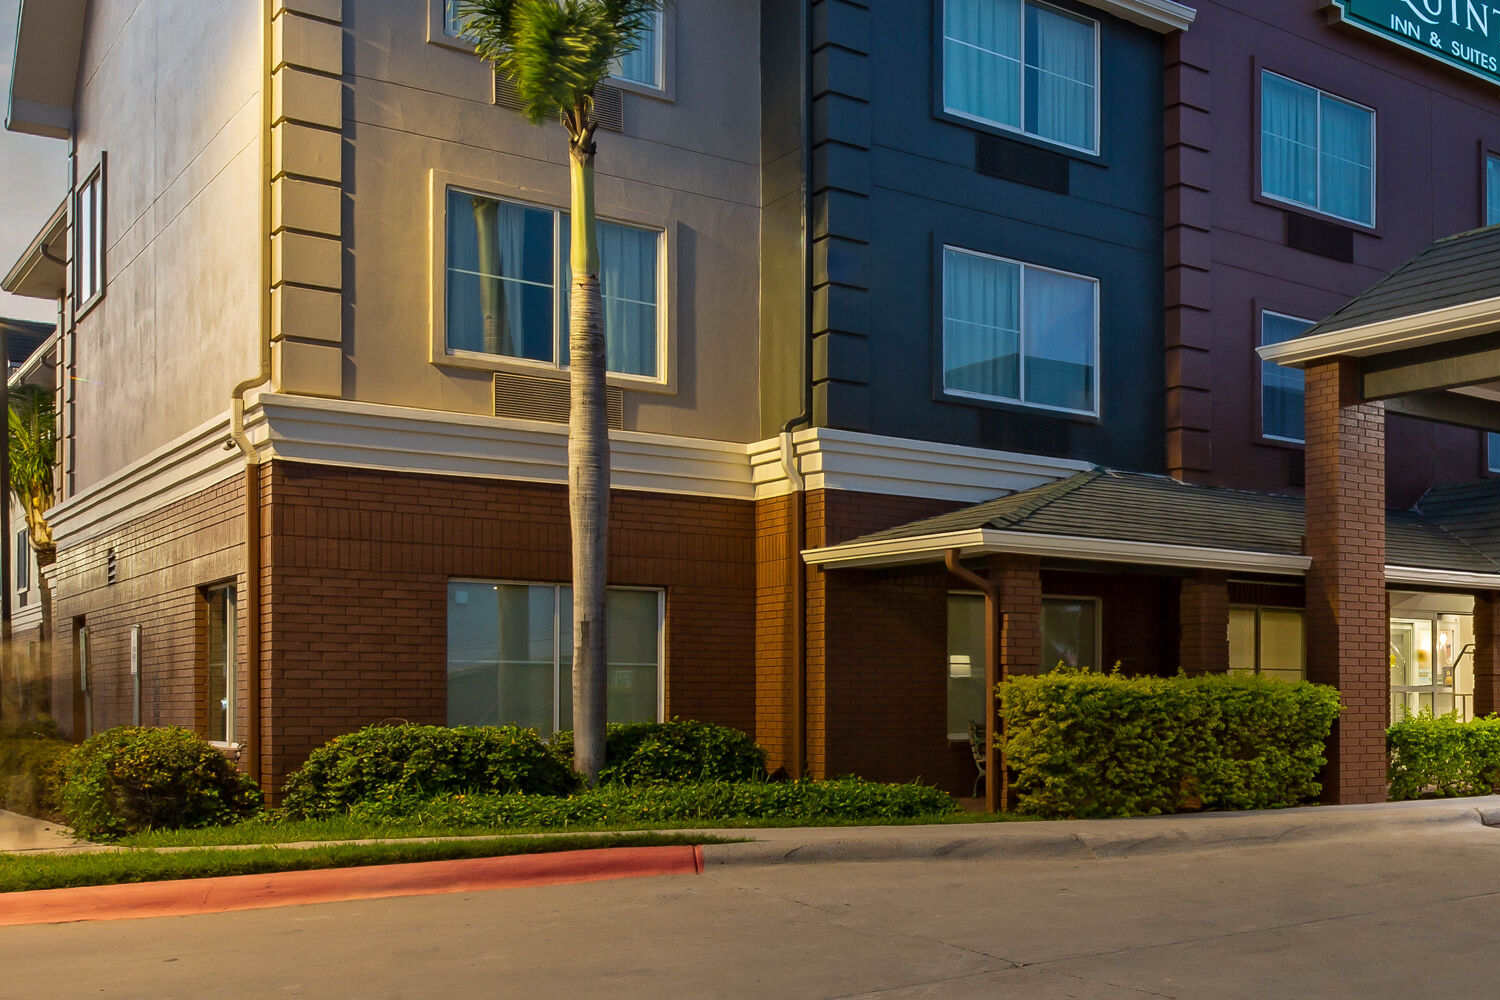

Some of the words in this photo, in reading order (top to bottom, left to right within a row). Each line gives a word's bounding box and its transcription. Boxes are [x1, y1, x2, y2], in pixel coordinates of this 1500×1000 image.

[1390, 13, 1421, 41] INN
[1429, 31, 1443, 49] &
[1451, 40, 1497, 72] SUITES
